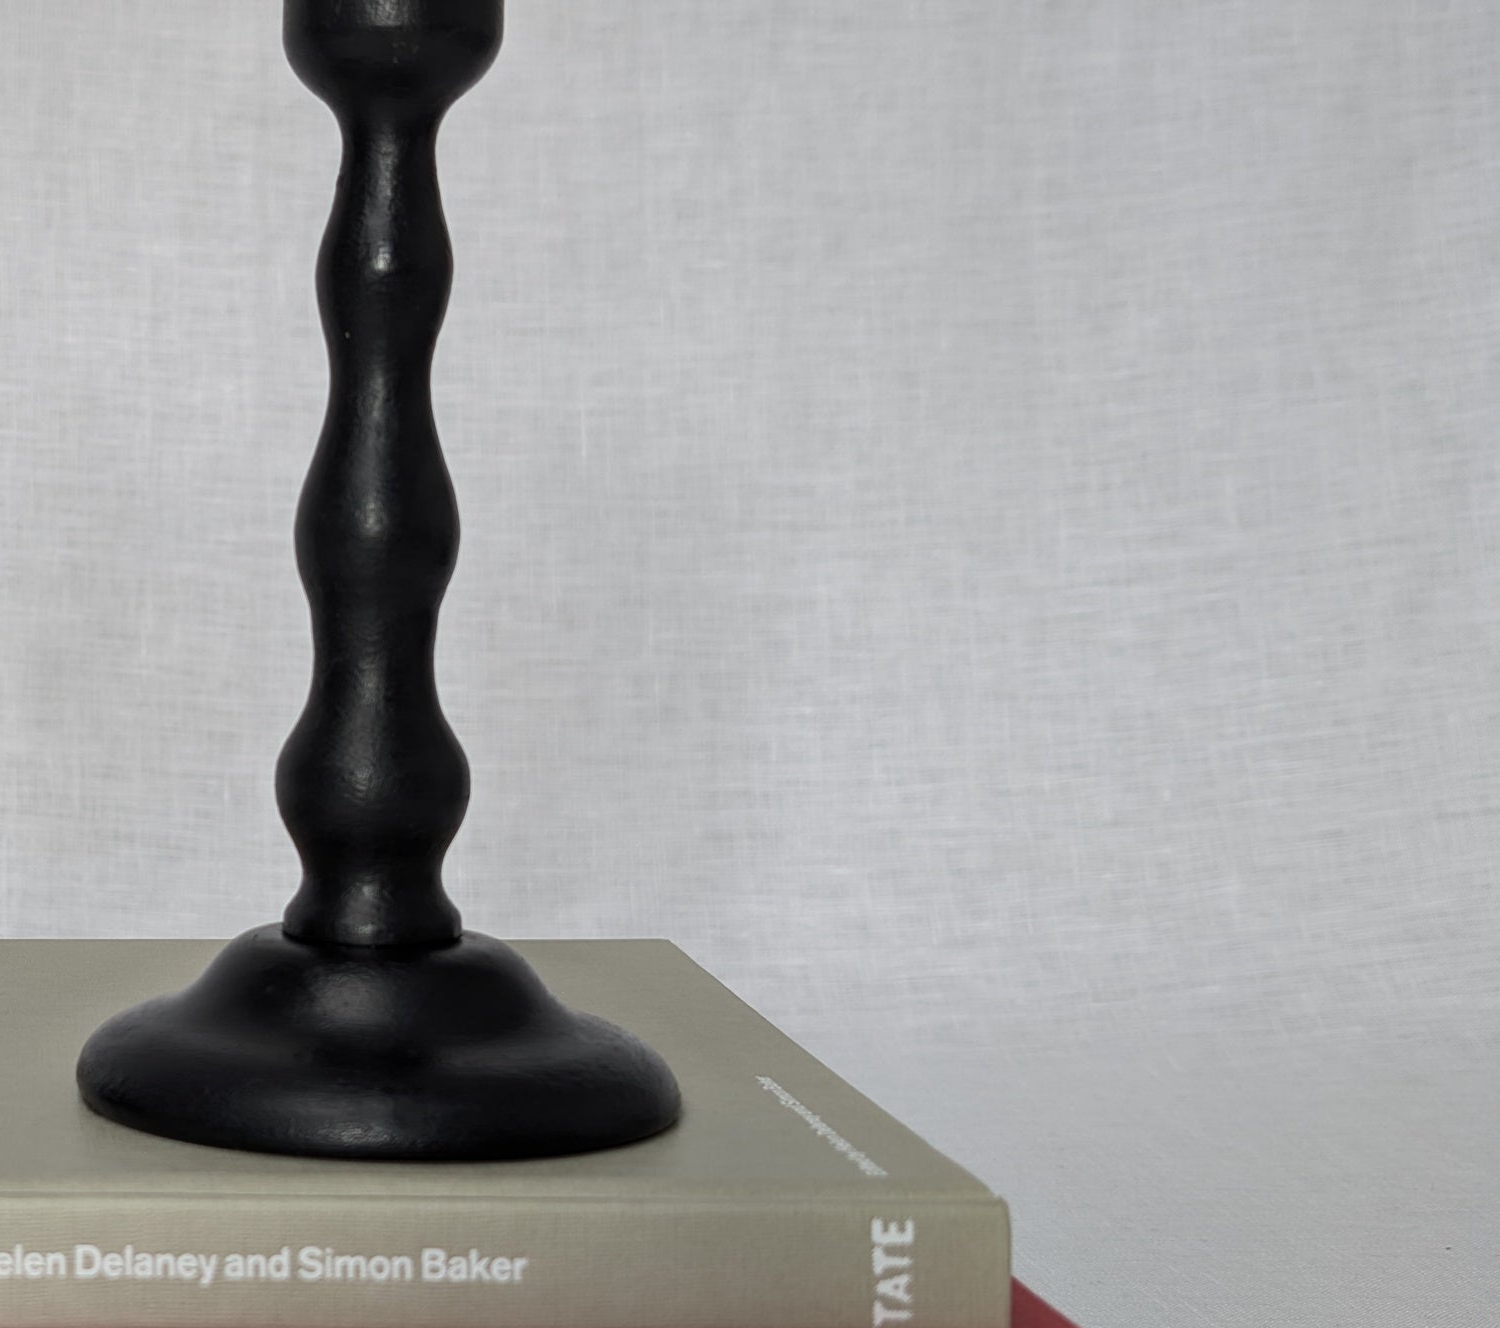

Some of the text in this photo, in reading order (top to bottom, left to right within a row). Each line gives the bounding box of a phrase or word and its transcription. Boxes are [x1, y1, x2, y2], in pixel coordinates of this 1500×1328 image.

[74, 1245, 219, 1286] Delaney
[224, 1247, 292, 1282] and
[298, 1246, 415, 1283] Simon
[421, 1248, 530, 1284] Baker
[871, 1218, 916, 1327] TATE
